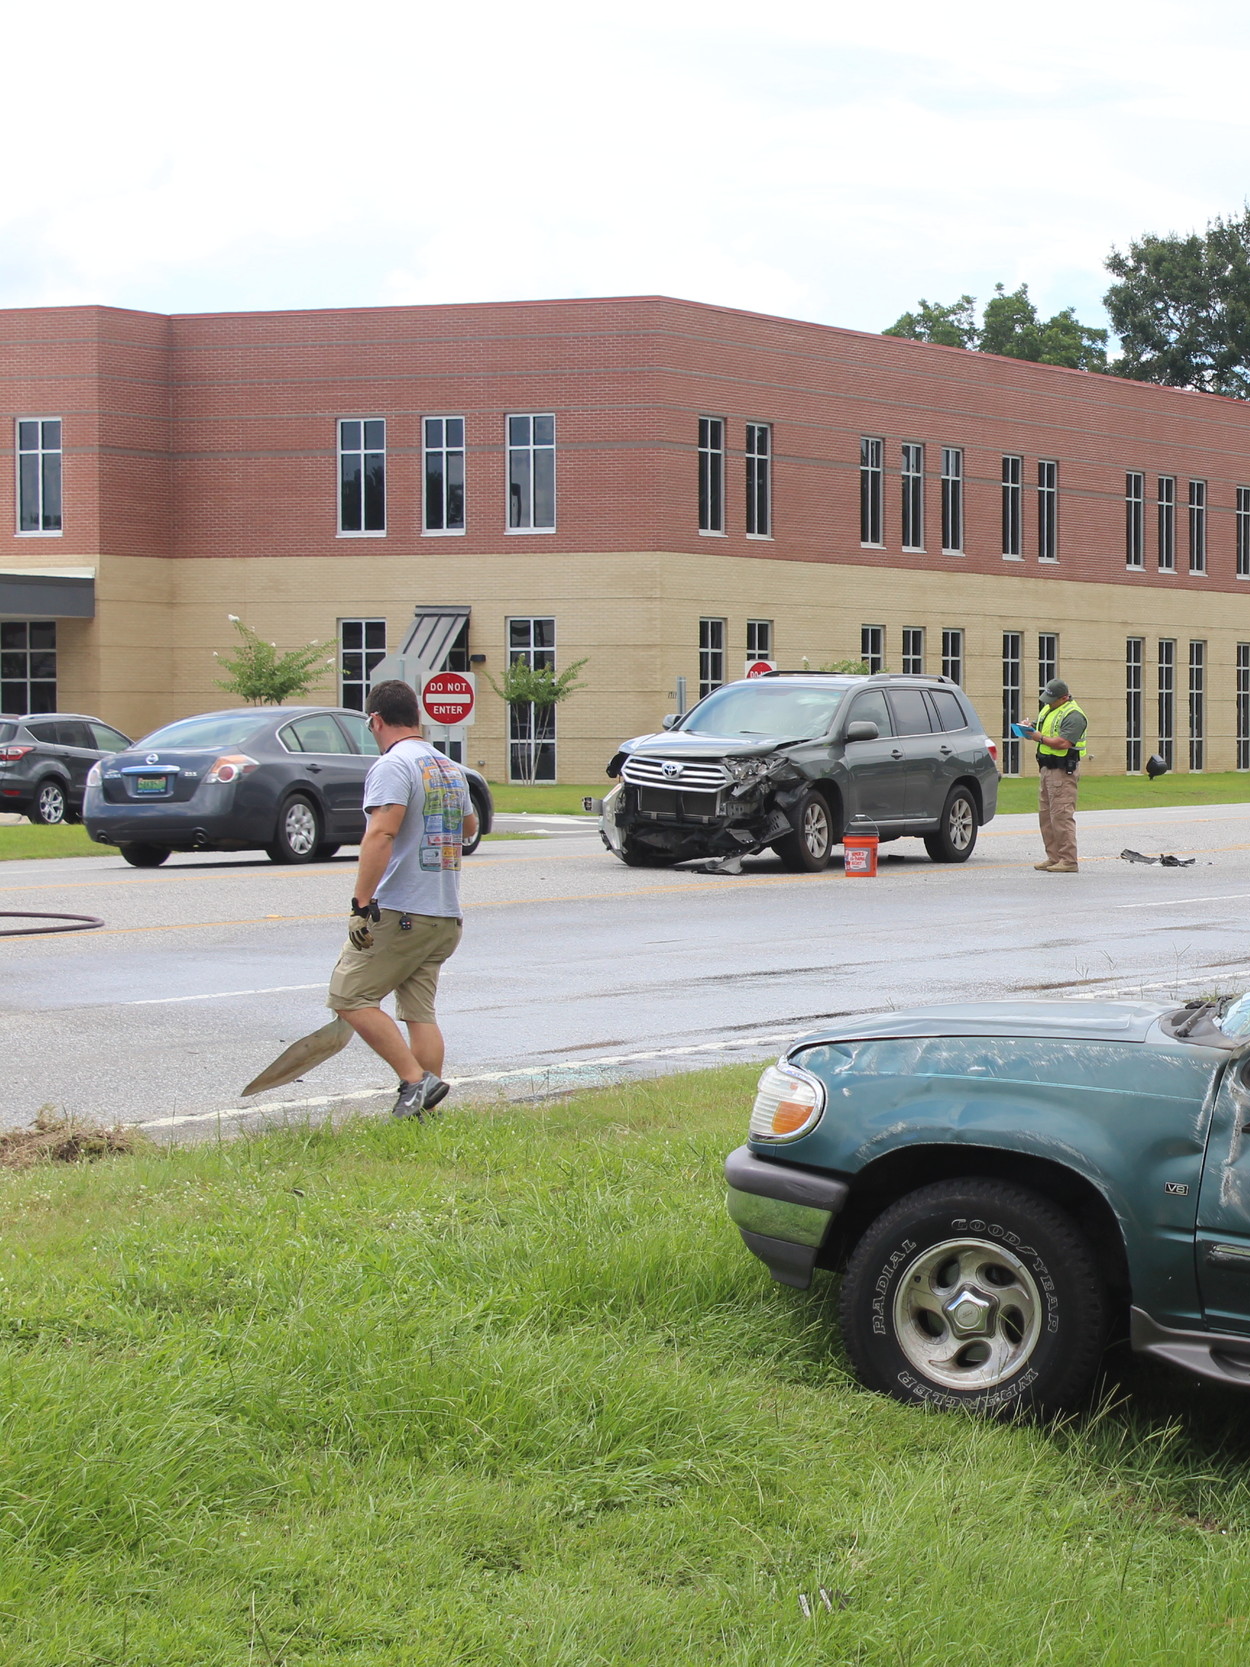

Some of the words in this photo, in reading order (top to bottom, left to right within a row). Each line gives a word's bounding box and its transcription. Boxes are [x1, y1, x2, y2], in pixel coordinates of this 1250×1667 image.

[430, 683, 443, 691] DO
[447, 683, 467, 691] NOT
[433, 706, 463, 714] ENTER
[1168, 1184, 1185, 1194] V8
[872, 1239, 917, 1335] RADIAL
